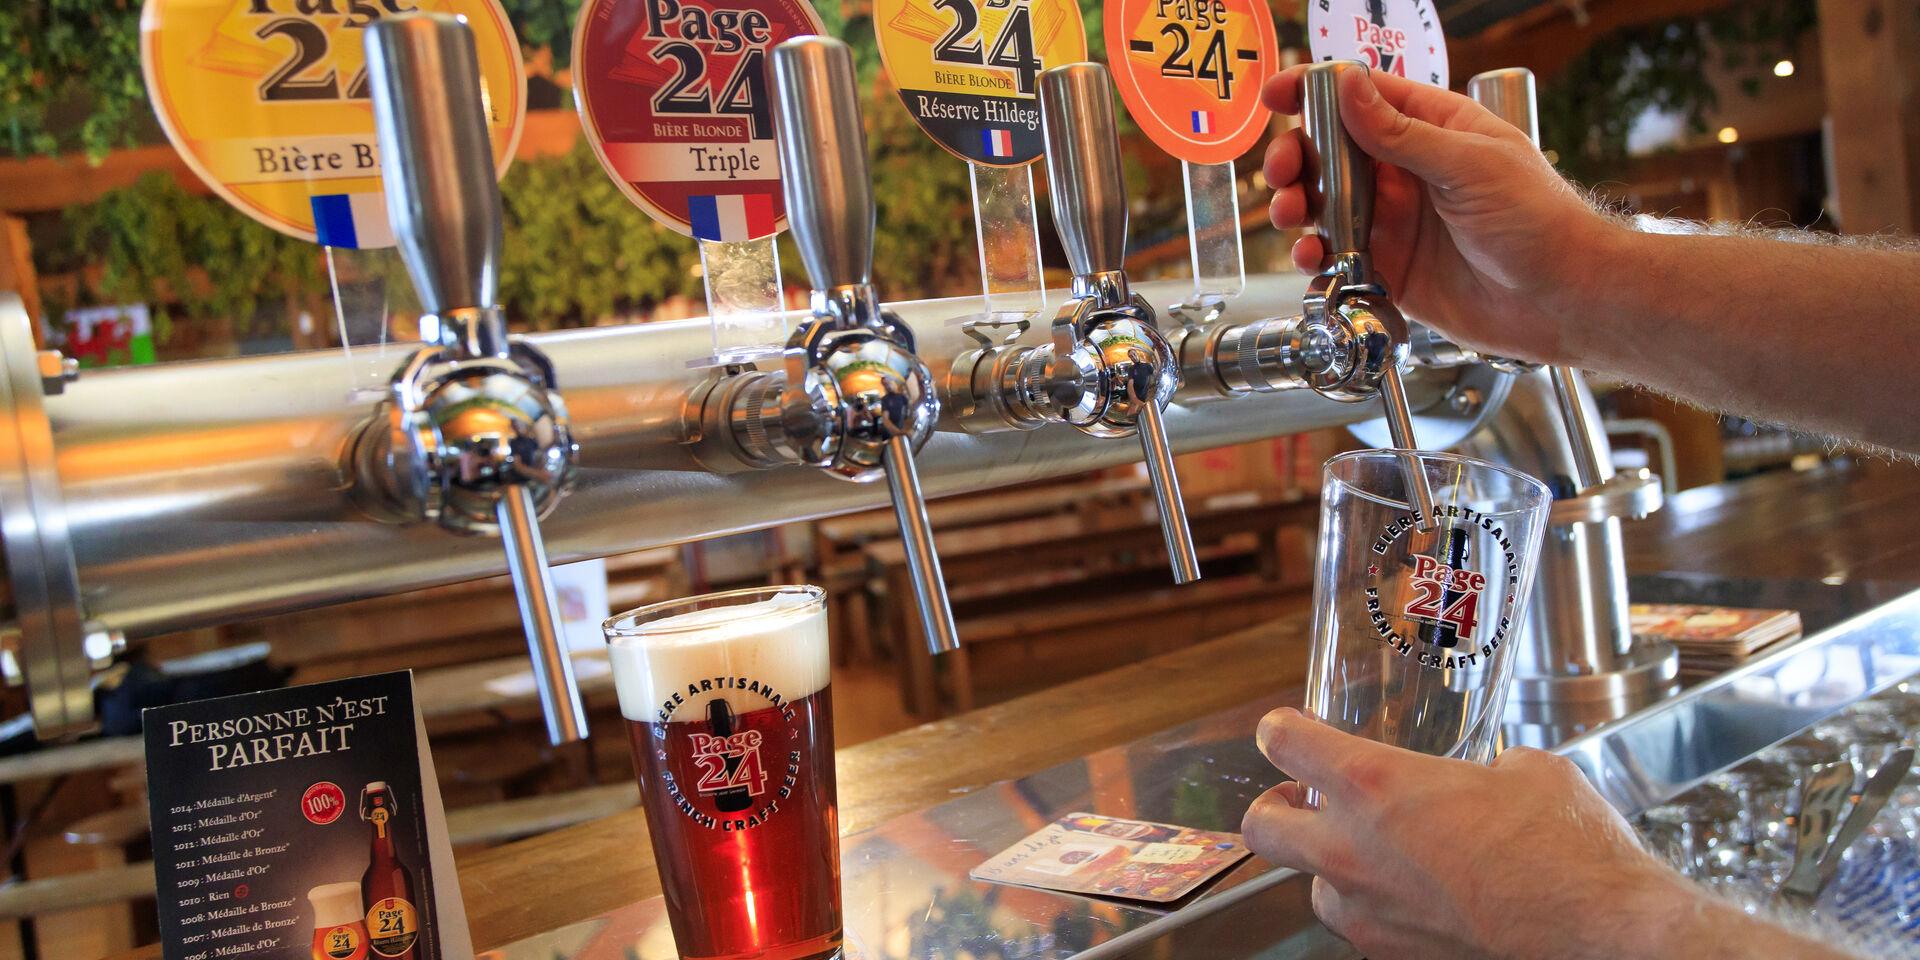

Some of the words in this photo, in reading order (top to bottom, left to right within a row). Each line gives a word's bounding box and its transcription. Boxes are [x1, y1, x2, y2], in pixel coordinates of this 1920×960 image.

[643, 0, 771, 53] Page
[1353, 16, 1405, 53] Page
[933, 0, 1042, 94] 24
[650, 41, 775, 140] 24
[968, 74, 1012, 90] BLONDE
[917, 95, 980, 121] Réserve
[693, 124, 743, 137] BLONDE
[253, 146, 343, 173] Bière
[689, 147, 760, 178] Triple
[1372, 510, 1424, 555] BIÈRE
[1432, 504, 1518, 585] ARTISANALE
[1409, 554, 1486, 592] Page
[1404, 580, 1479, 640] 24
[1365, 587, 1413, 657] FRENCH
[1417, 651, 1477, 669] CRAFT
[1482, 617, 1510, 658] BEER
[688, 677, 795, 722] ARTISANALE
[208, 724, 354, 772] PARFAIT
[688, 730, 762, 758] Page
[695, 748, 768, 797] 24
[196, 797, 236, 810] Médaille
[307, 793, 340, 815] 100%
[662, 770, 716, 830] FRENCH
[722, 800, 779, 832] CRAFT
[779, 751, 800, 799] BEER
[198, 814, 238, 828] Médaille
[200, 833, 240, 847] Médaille
[202, 851, 241, 865] Médaille
[242, 849, 253, 858] de
[206, 870, 245, 883] Médaille
[208, 891, 230, 902] Rien
[207, 906, 247, 920] Médaille
[248, 904, 259, 913] de
[378, 909, 404, 919] Page
[211, 926, 250, 940] Médaille
[252, 923, 263, 931] de
[379, 916, 405, 935] 24
[215, 943, 255, 958] Médaille
[333, 939, 351, 949] 24
